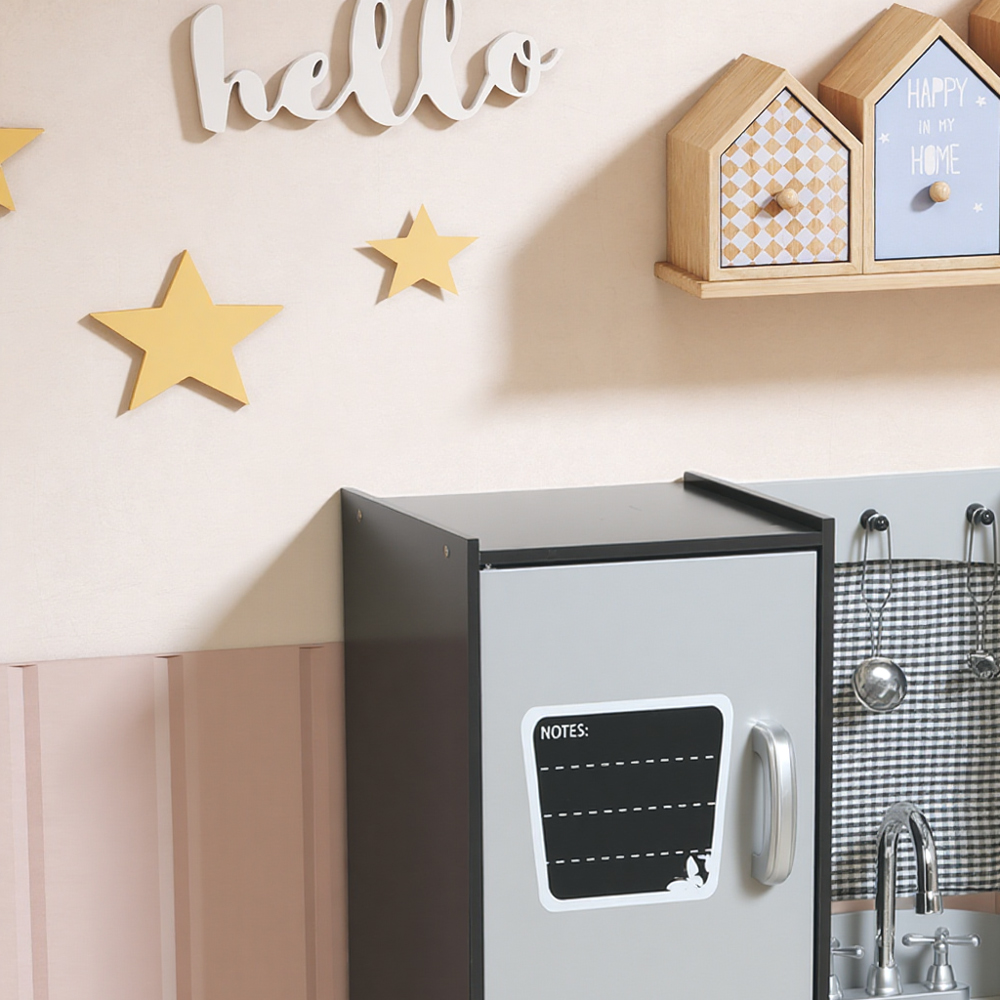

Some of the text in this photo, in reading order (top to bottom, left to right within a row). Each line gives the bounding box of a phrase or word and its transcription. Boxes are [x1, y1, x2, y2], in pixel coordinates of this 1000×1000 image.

[190, 0, 563, 132] hello
[908, 77, 968, 109] HAPPY
[918, 118, 955, 135] IN MY
[911, 143, 961, 175] HOME
[540, 723, 589, 740] NOTES:
